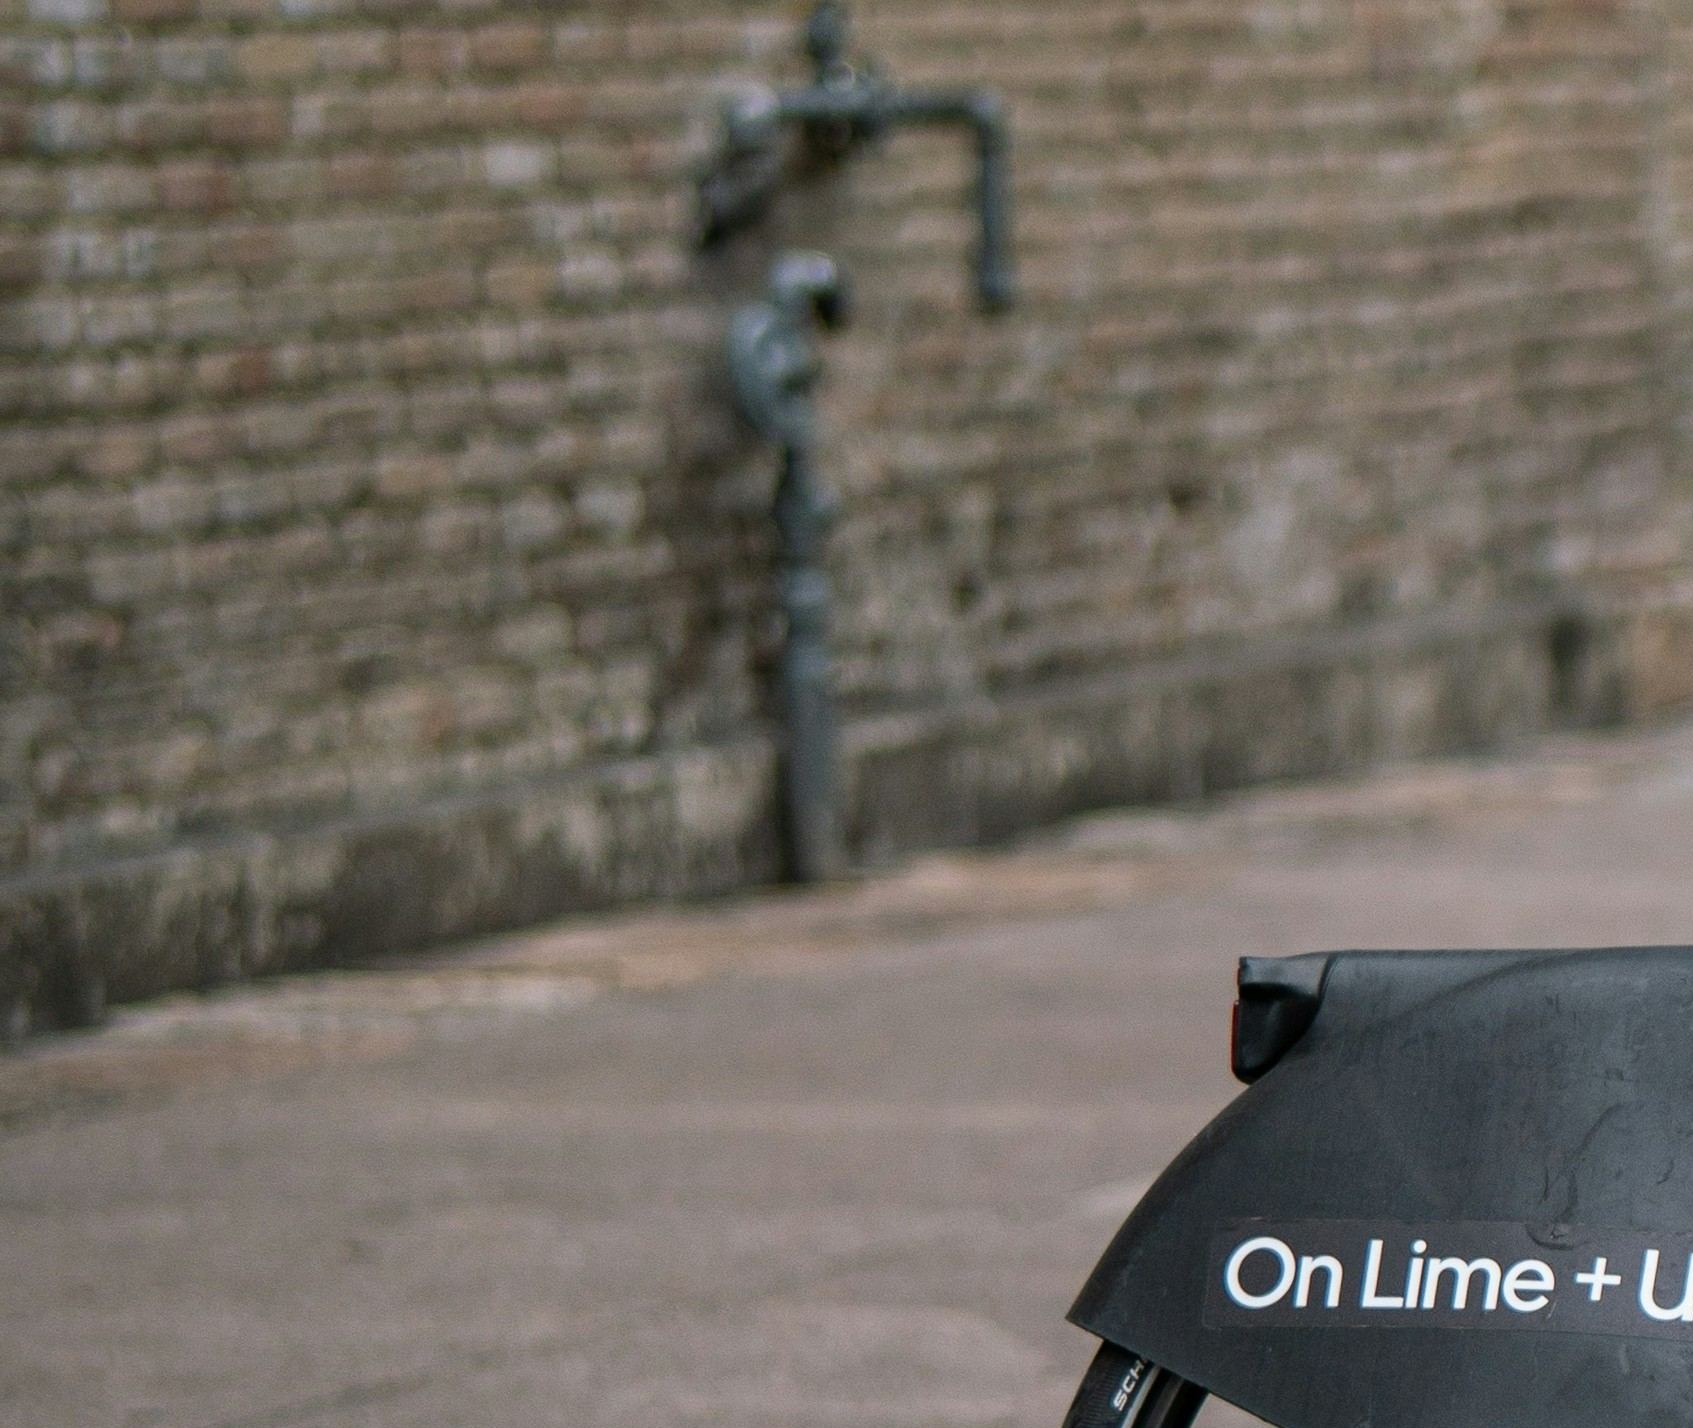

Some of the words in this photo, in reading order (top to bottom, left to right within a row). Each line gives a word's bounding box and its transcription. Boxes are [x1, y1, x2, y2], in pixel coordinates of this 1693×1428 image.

[1224, 1236, 1343, 1309] On
[1361, 1239, 1554, 1313] Lime
[1575, 1256, 1622, 1302] +
